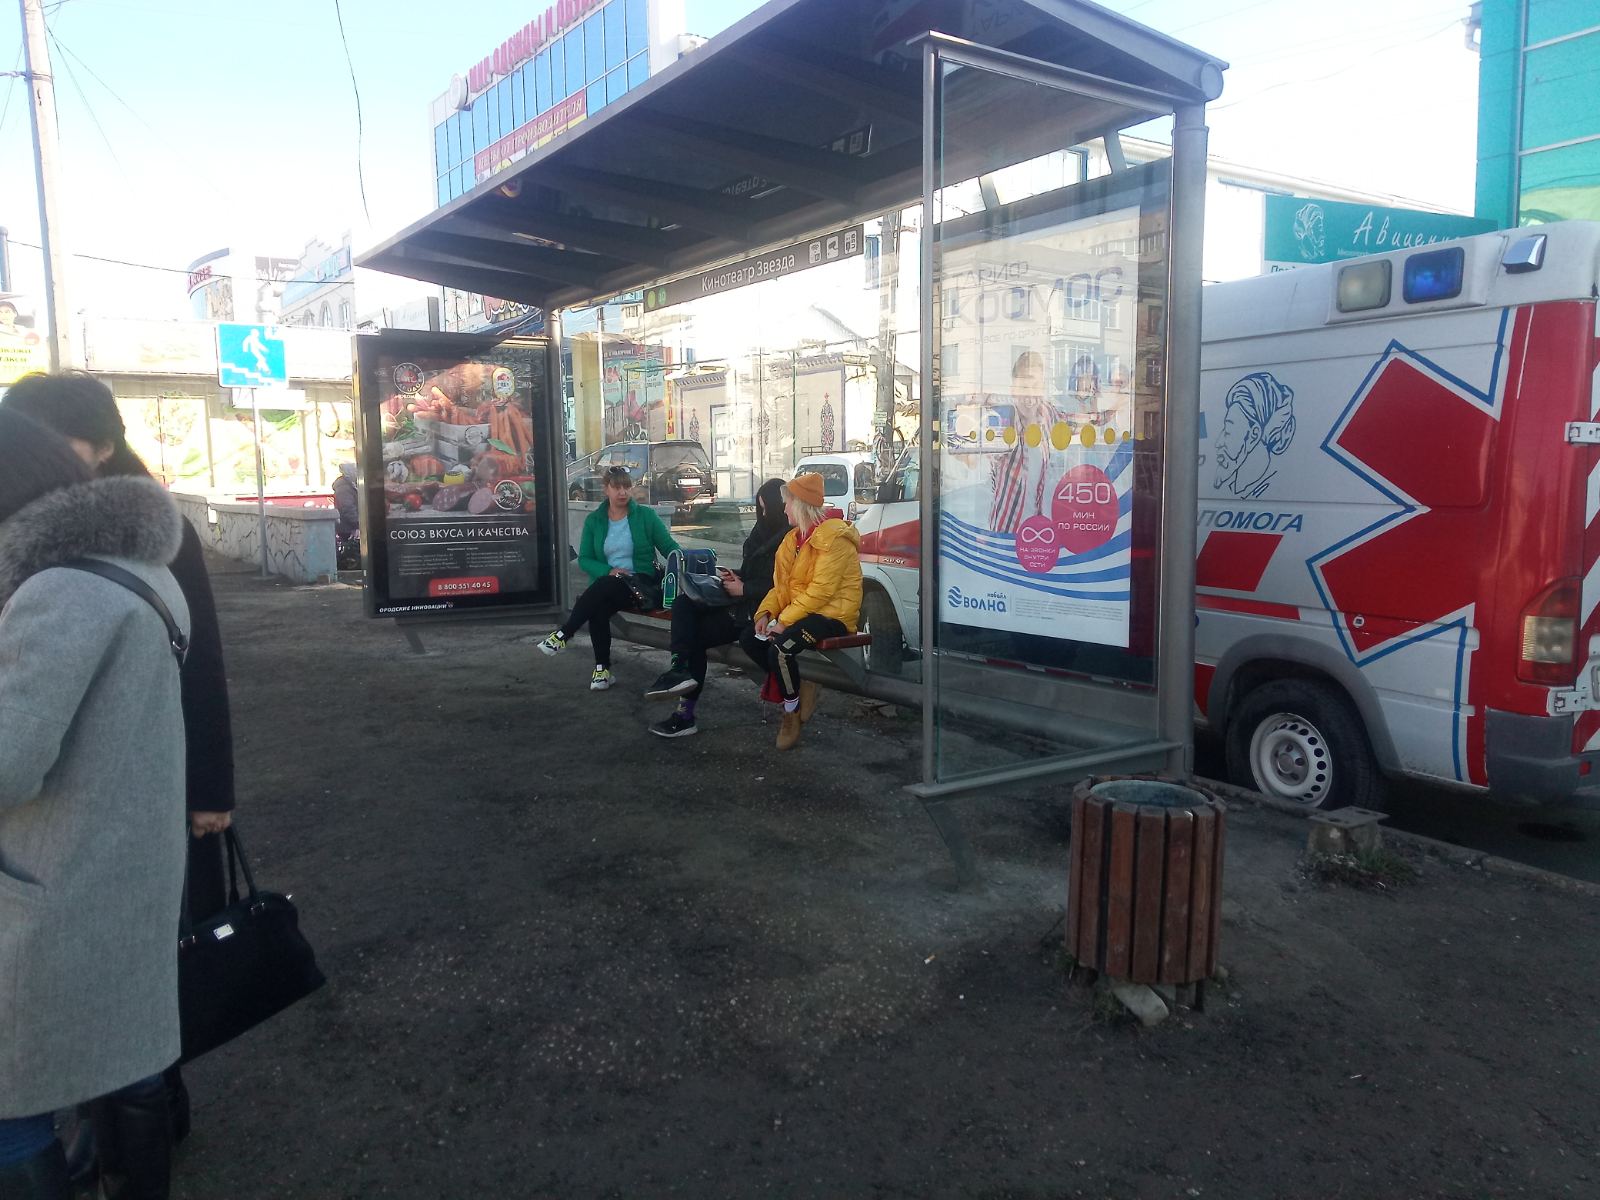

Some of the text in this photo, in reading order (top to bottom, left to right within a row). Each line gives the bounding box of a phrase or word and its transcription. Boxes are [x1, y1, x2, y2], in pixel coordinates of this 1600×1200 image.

[1352, 211, 1462, 248] Авицен
[701, 253, 796, 292] Кинотеатр Звезда
[951, 266, 1124, 326] КОСМОС
[1057, 482, 1111, 504] 450
[1072, 511, 1095, 519] МИН
[390, 527, 529, 540] СОЮЗ ВКУСА И КАЧЕСТВА
[1058, 522, 1110, 531] ПО РОССИИ
